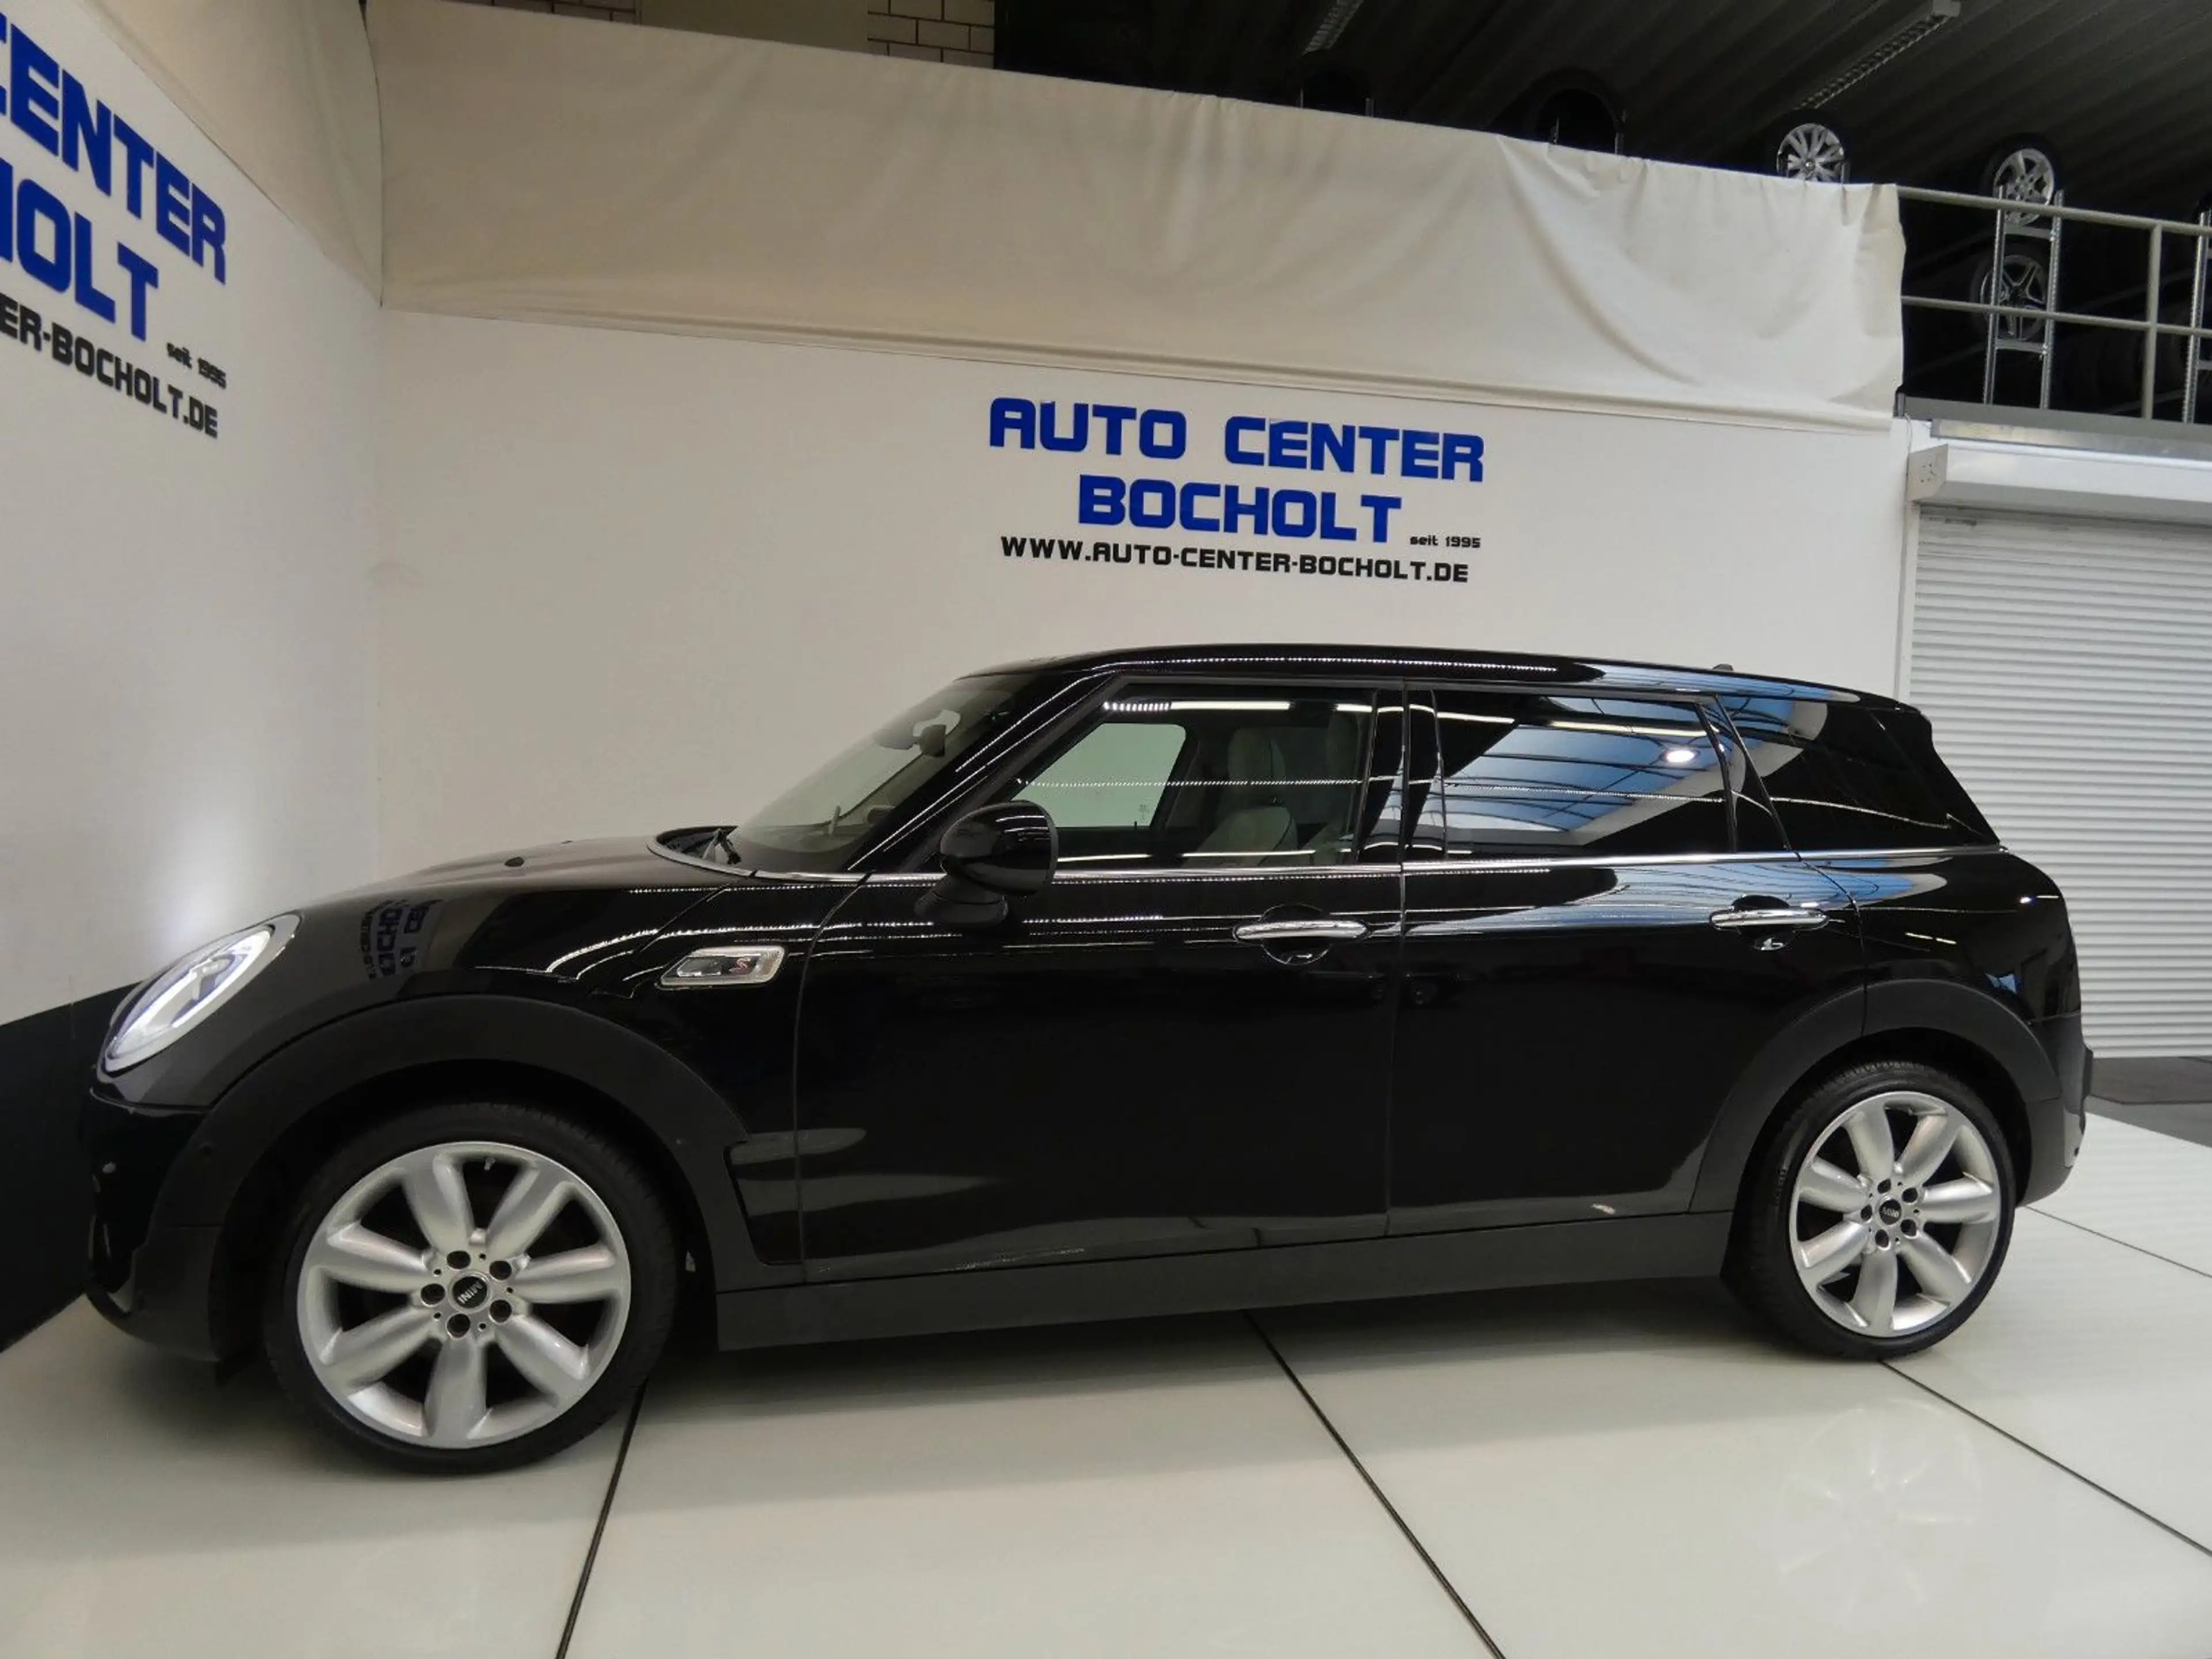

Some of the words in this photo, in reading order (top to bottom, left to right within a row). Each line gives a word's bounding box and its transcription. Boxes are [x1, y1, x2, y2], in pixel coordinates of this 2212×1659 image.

[0, 13, 226, 285] ENTER
[0, 157, 158, 342] OLT
[990, 397, 1187, 461] AUTO
[1225, 415, 1485, 483] CENTER
[1078, 474, 1402, 544] BOCHOLT
[1410, 535, 1439, 546] seit
[1445, 535, 1482, 548] 1995
[1000, 535, 1469, 583] WWW.AUTO-CENTER-BOCHOLT.DE
